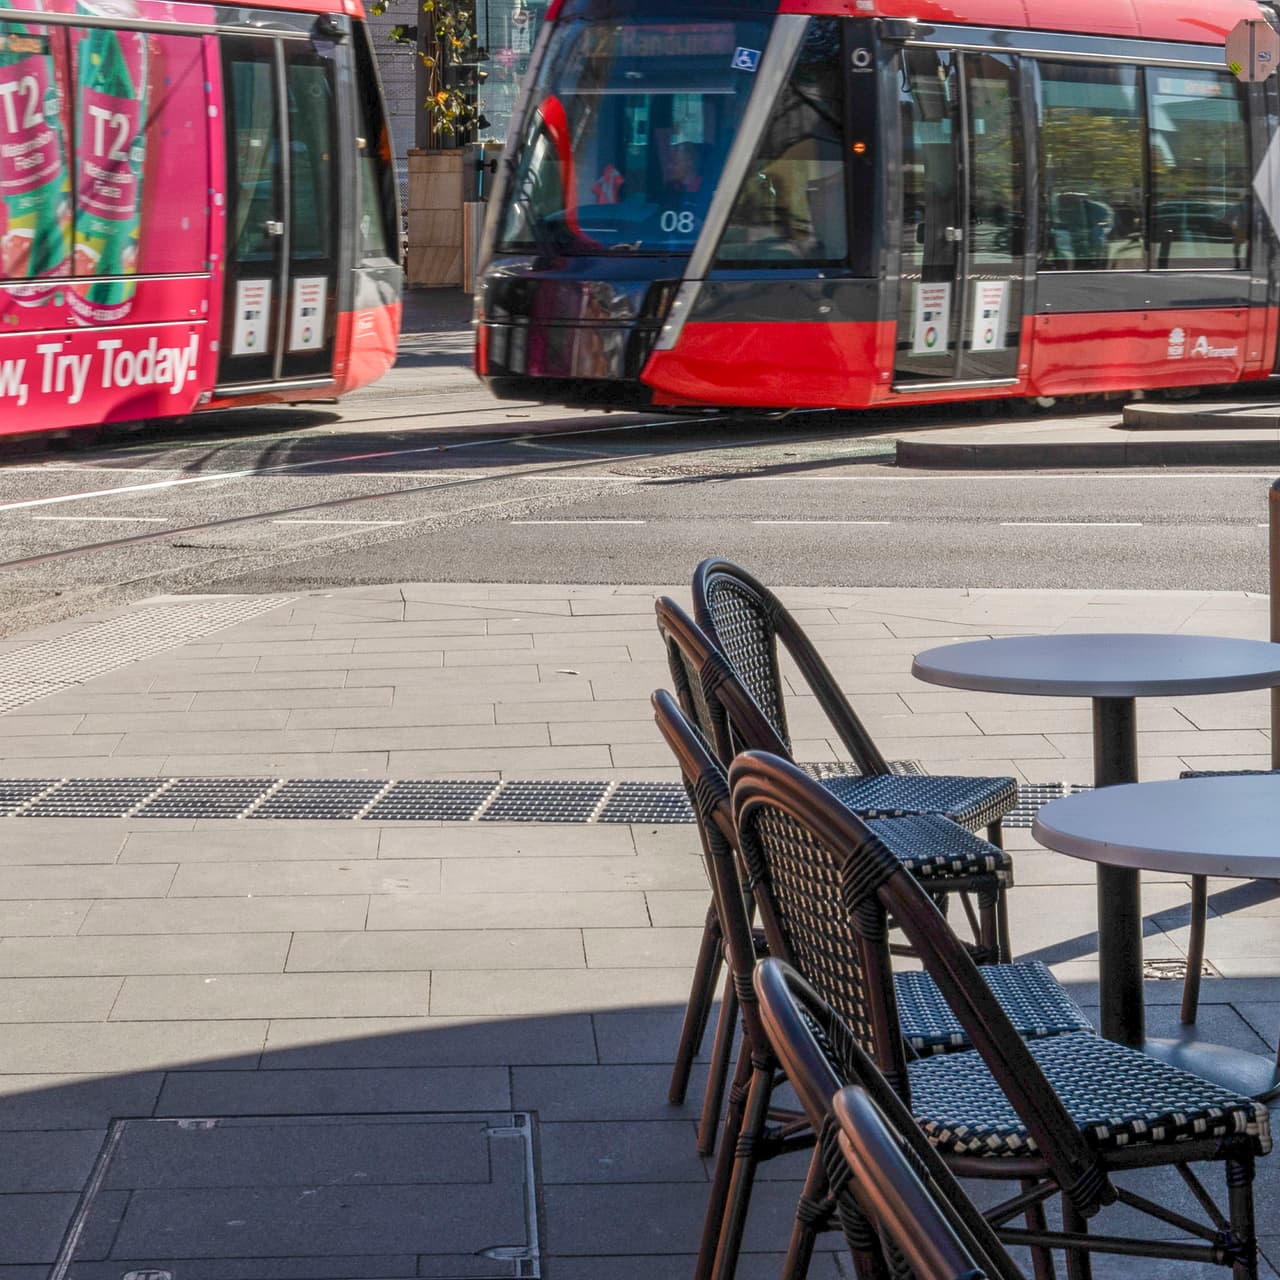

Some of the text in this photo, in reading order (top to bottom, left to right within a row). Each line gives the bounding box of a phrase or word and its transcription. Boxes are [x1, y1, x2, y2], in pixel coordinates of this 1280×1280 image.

[88, 104, 131, 162] T2
[660, 210, 695, 233] 08
[36, 343, 93, 405] Try
[97, 334, 200, 395] Today!
